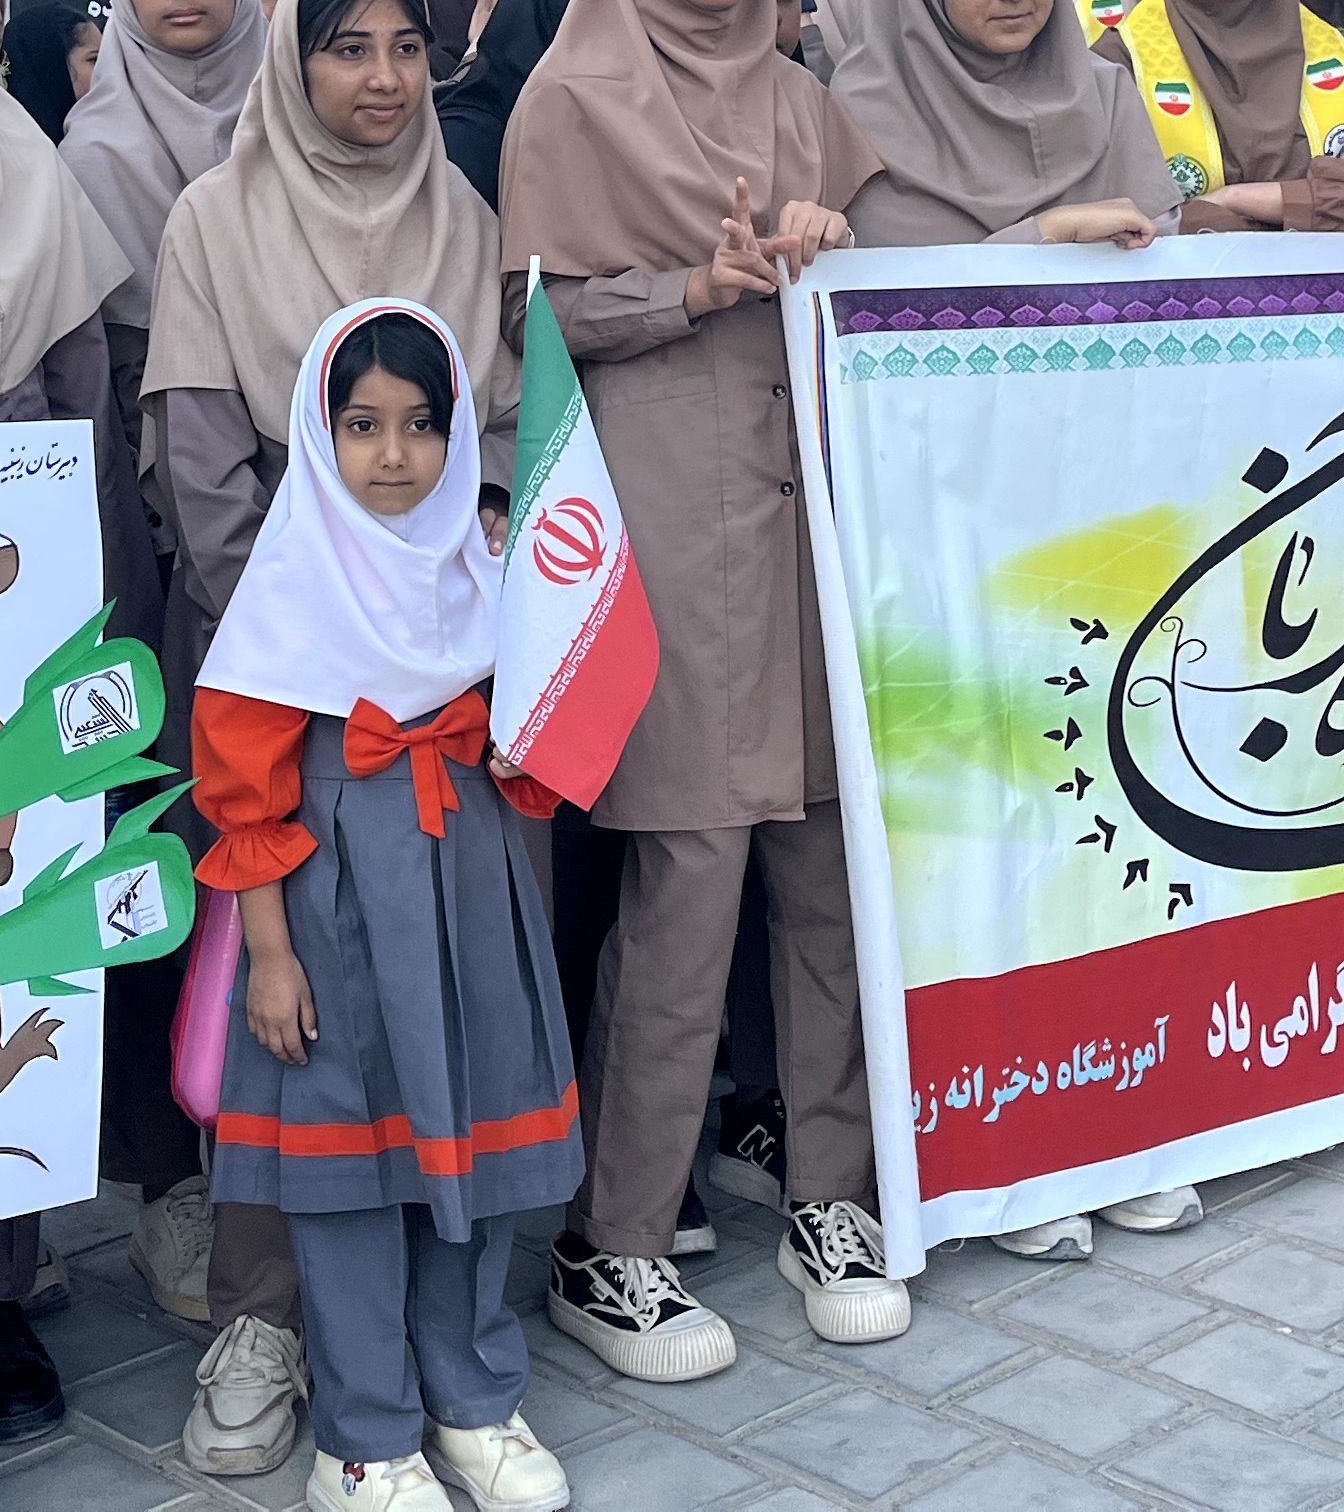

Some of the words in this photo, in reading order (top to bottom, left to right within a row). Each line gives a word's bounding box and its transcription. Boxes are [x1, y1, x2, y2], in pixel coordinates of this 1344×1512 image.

[26, 442, 78, 480] دبیرستان
[1056, 1015, 1171, 1091] آموزشگاه
[1207, 981, 1252, 1072] باد
[944, 1056, 1050, 1123] دخترانه
